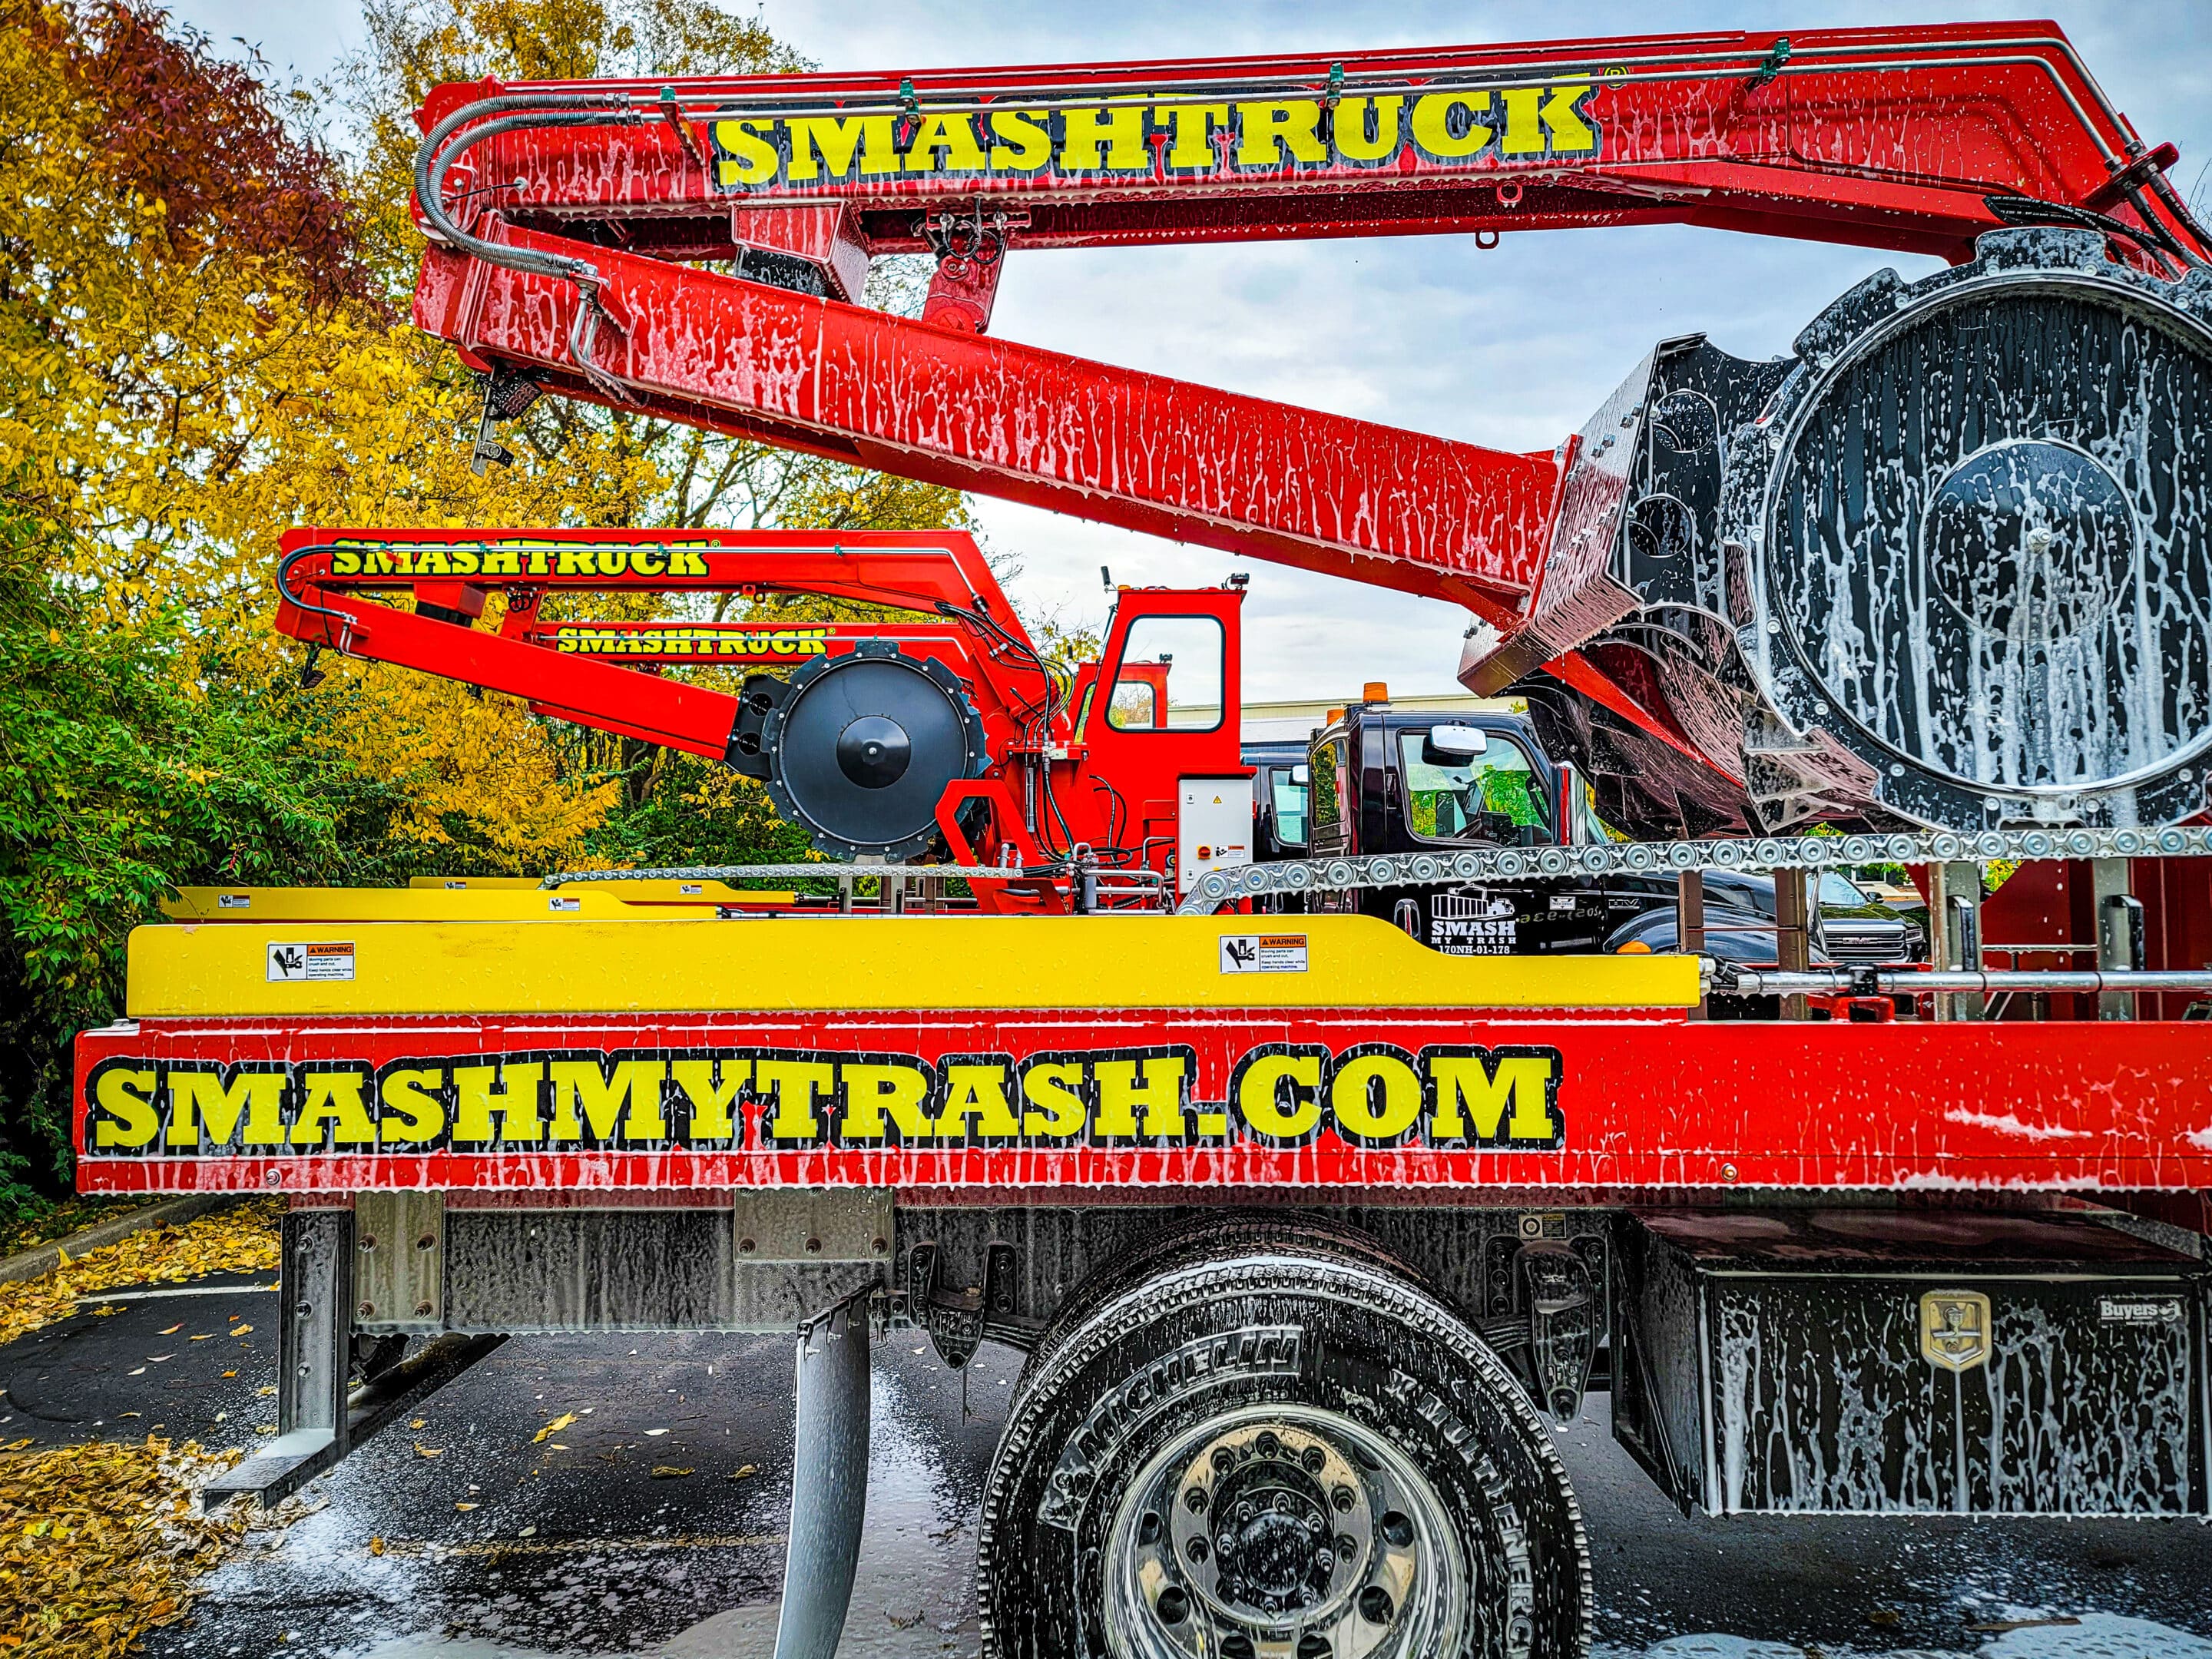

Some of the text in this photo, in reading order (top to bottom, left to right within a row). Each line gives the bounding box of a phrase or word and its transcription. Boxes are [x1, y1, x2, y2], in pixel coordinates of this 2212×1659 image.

[1432, 920, 1516, 936] SMASH
[1439, 945, 1510, 954] 170NH-01-178
[94, 1055, 1556, 1150] SMASHMYTRASH.COM
[2100, 1301, 2158, 1320] Buyers
[1075, 1335, 1298, 1467] MICHELIN
[1493, 1502, 1535, 1659] ENERG
